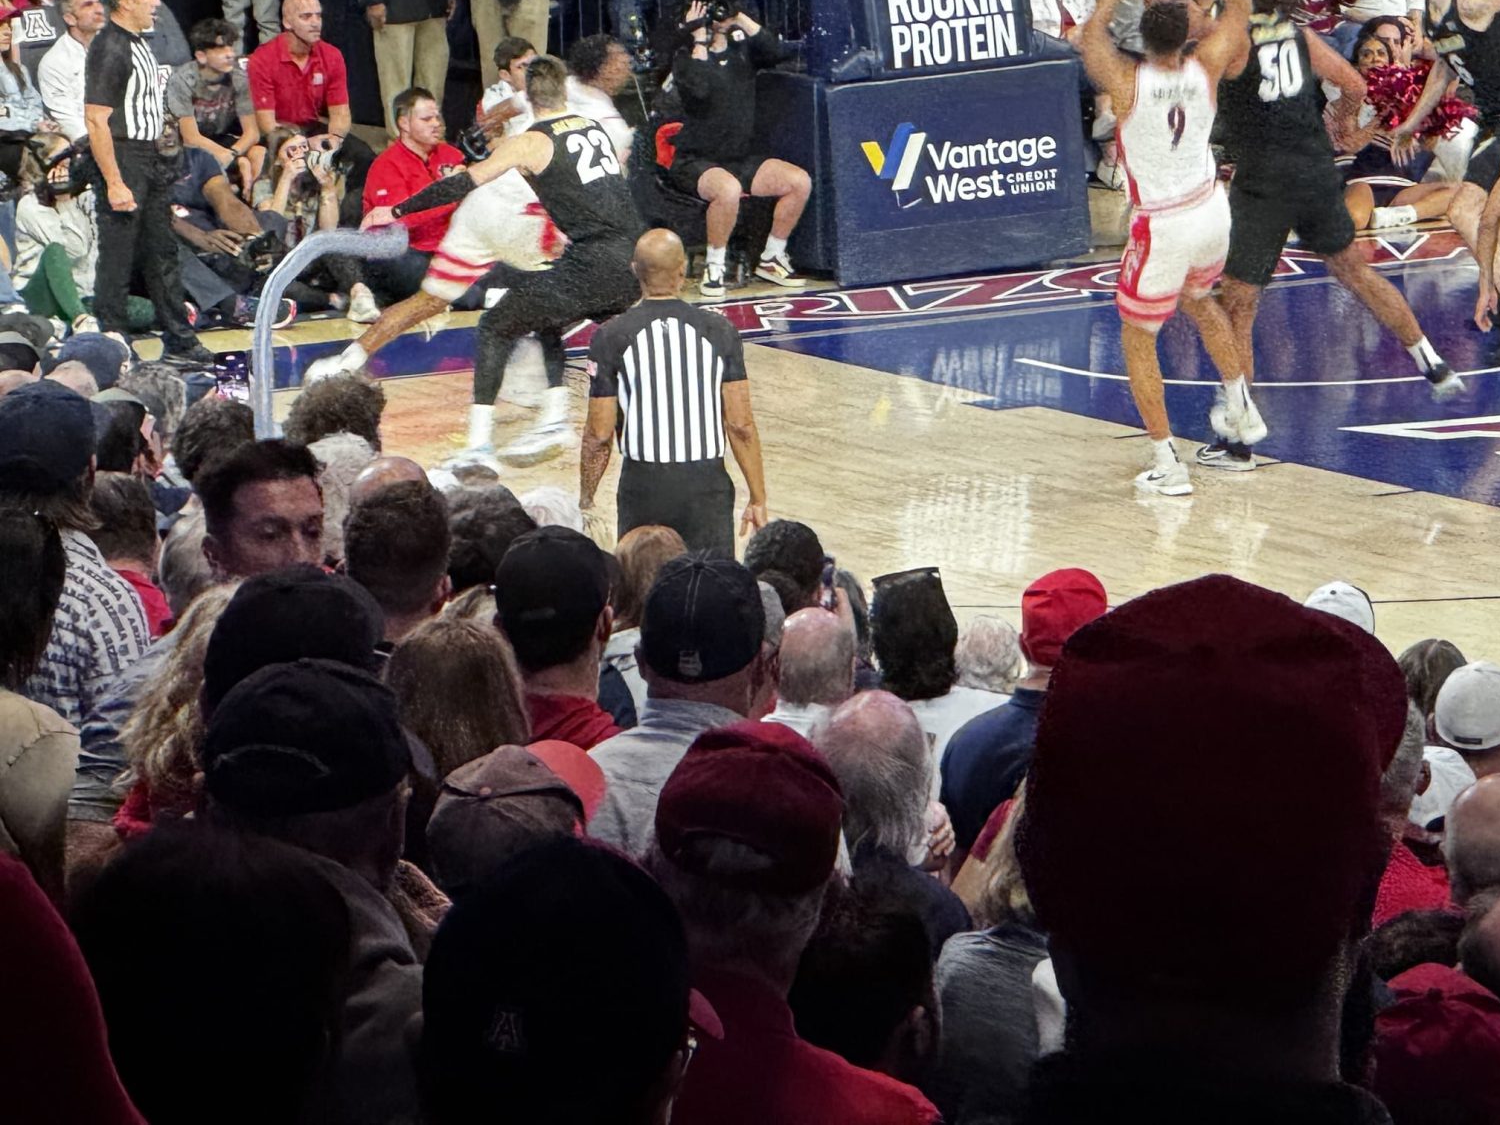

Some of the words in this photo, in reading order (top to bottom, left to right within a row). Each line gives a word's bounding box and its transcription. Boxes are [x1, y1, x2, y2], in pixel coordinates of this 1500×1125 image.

[23, 9, 61, 42] A
[890, 12, 1018, 70] PROTEIN
[1258, 39, 1304, 103] 50
[1166, 105, 1186, 152] 9
[566, 128, 620, 186] 23
[926, 135, 1058, 172] Vantage
[925, 169, 1006, 204] West
[1006, 168, 1058, 186] CREDIT
[1010, 180, 1057, 196] UNION
